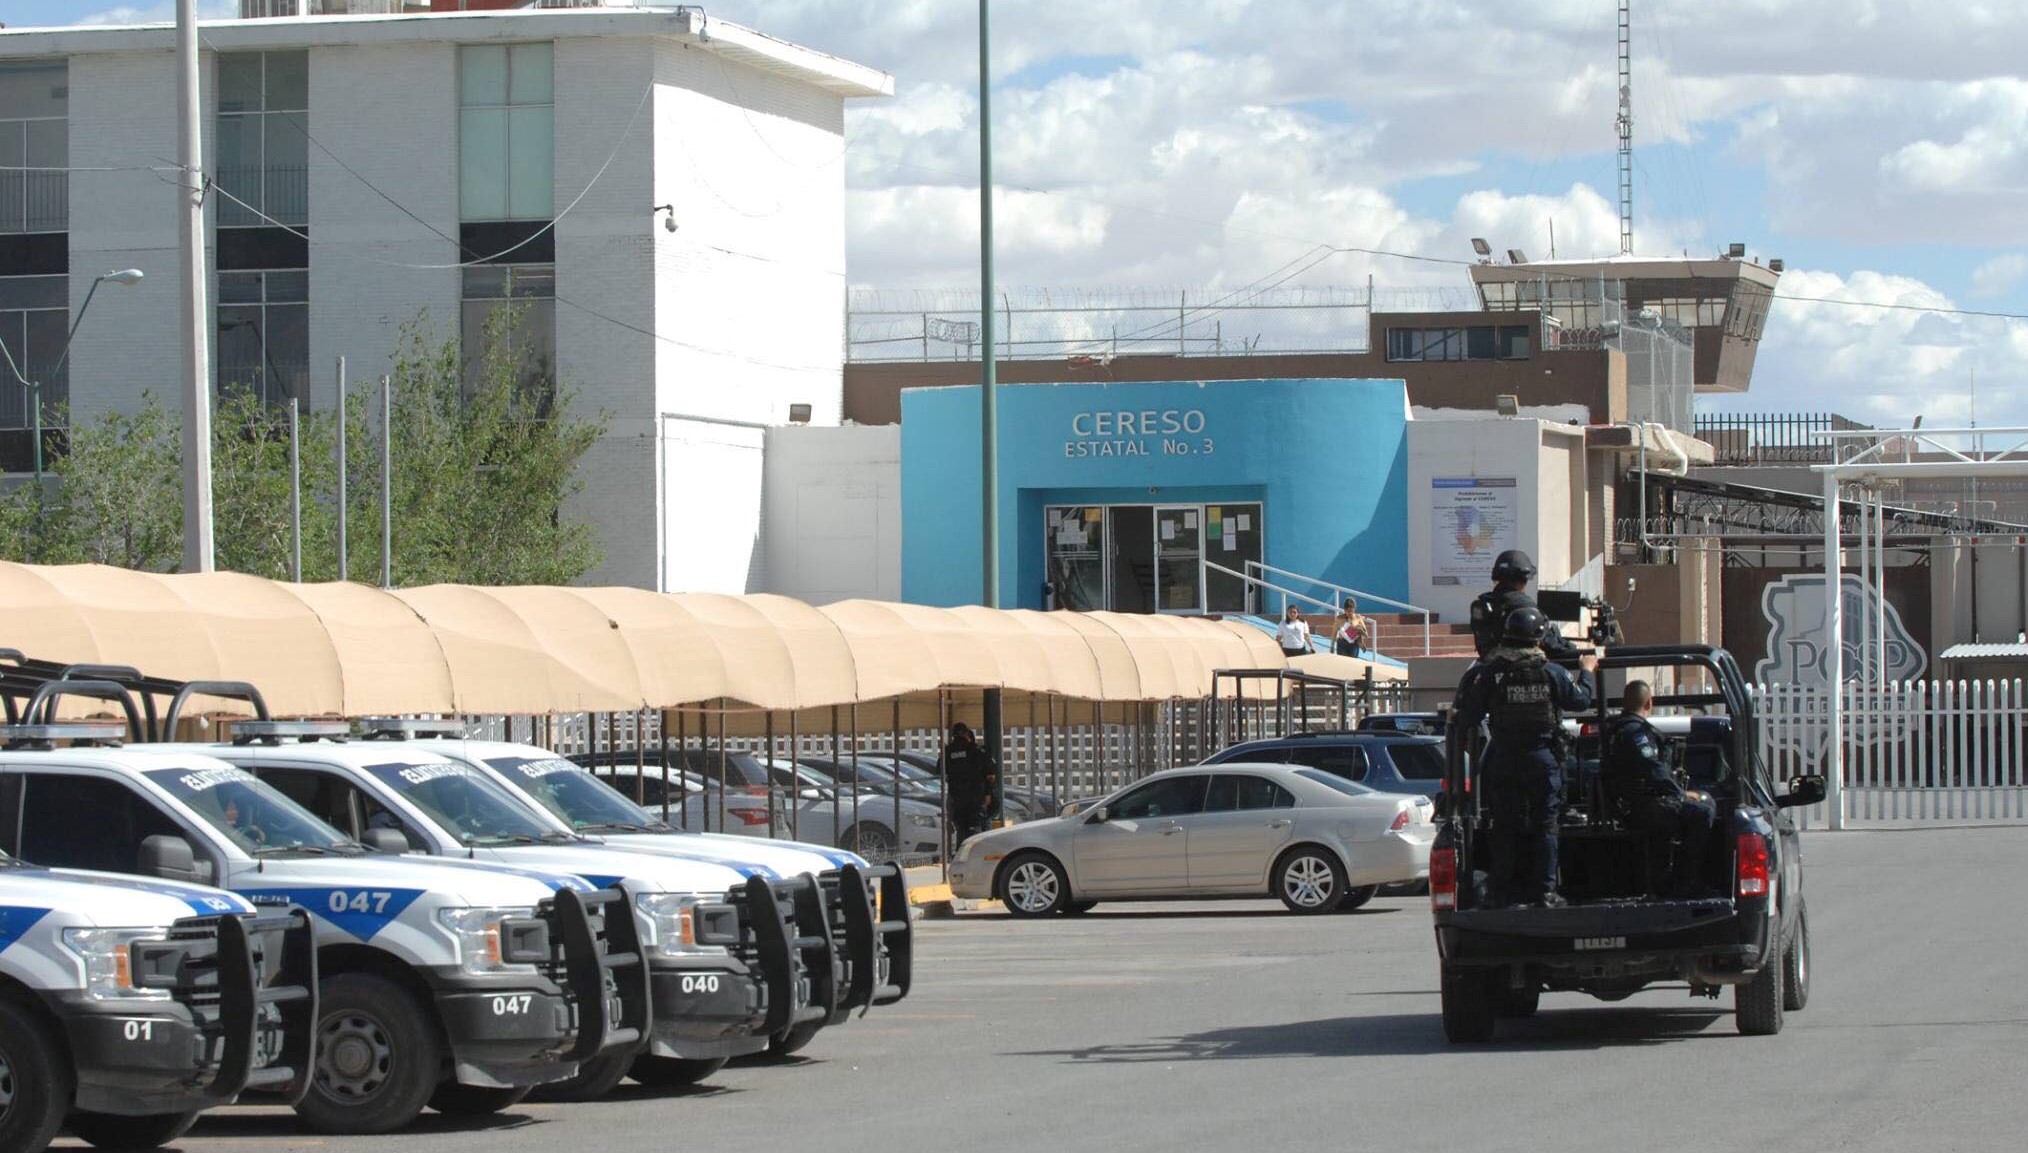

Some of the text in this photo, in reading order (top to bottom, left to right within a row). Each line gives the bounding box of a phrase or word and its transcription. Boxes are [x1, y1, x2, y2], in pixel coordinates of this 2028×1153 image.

[1072, 409, 1206, 437] CERESO
[1065, 439, 1150, 458] ESTATAL
[1506, 684, 1551, 693] POLICIA
[328, 890, 392, 914] 047
[681, 975, 719, 993] 040
[492, 995, 532, 1015] 047
[124, 1020, 152, 1040] 01
